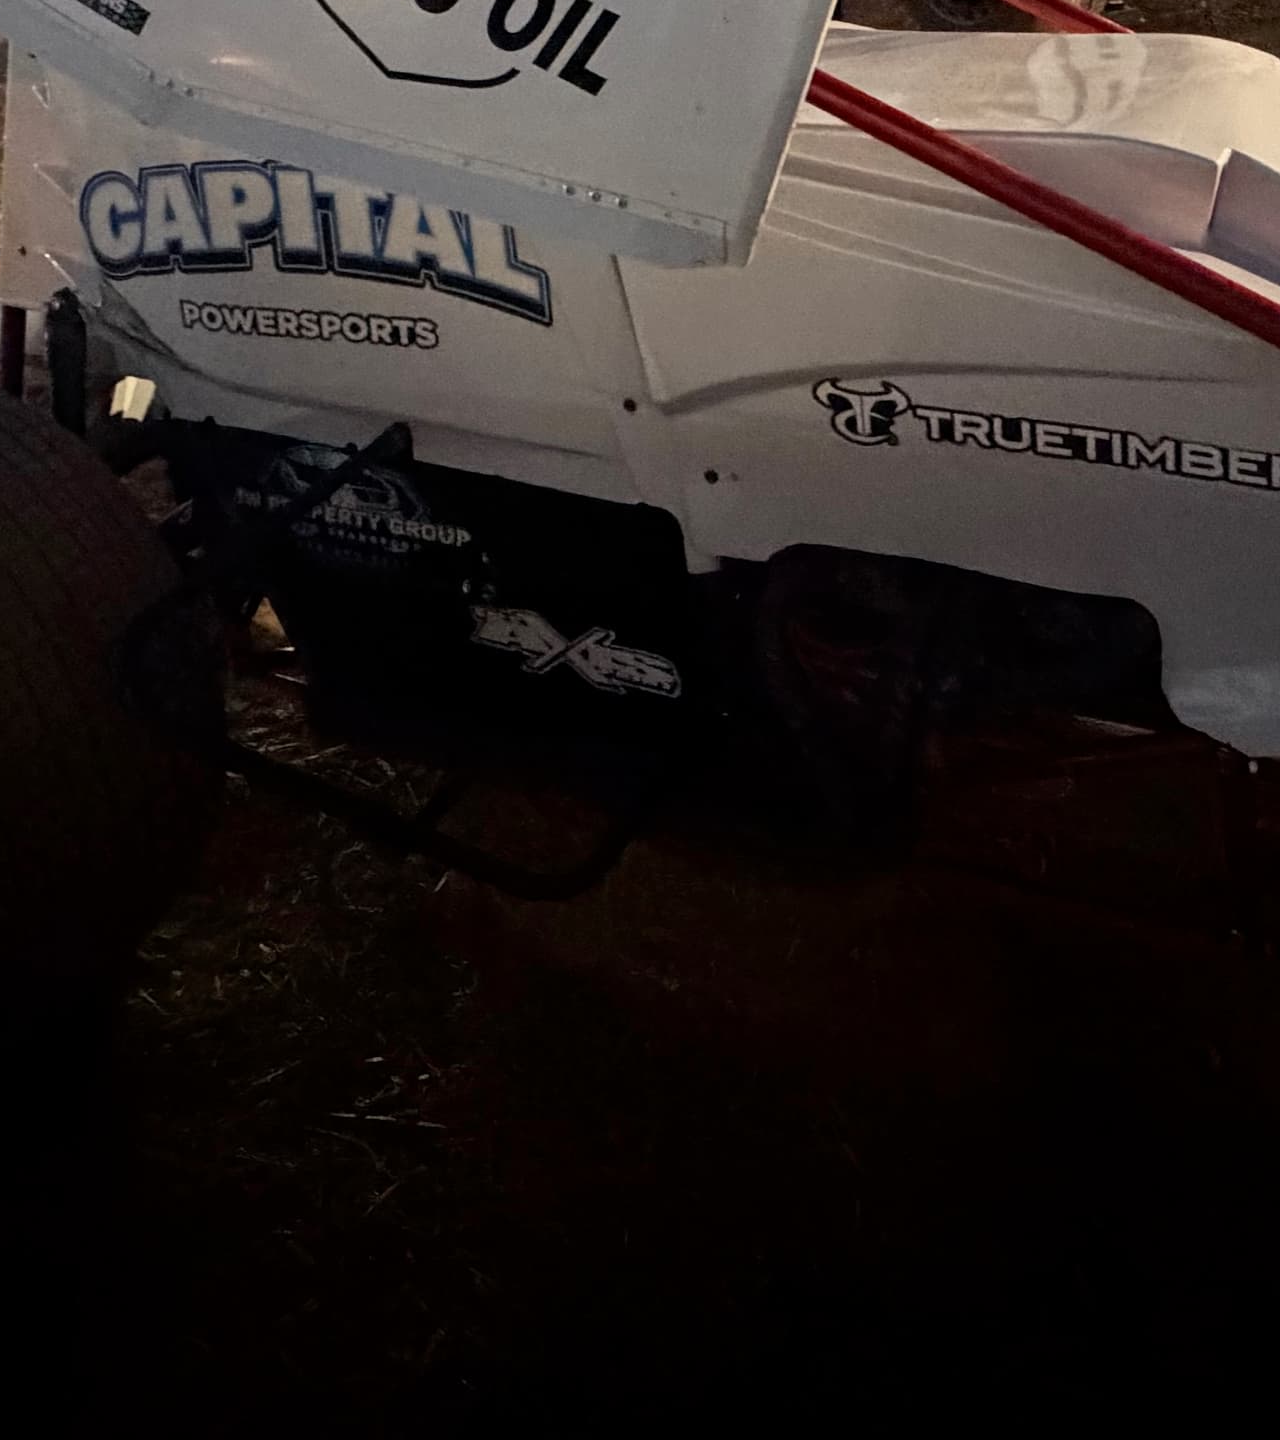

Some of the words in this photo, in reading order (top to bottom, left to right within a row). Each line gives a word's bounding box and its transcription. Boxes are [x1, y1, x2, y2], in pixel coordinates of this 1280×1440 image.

[80, 159, 553, 325] CAPITAL
[179, 300, 439, 349] POWERSPORTS
[389, 517, 472, 548] GROUP
